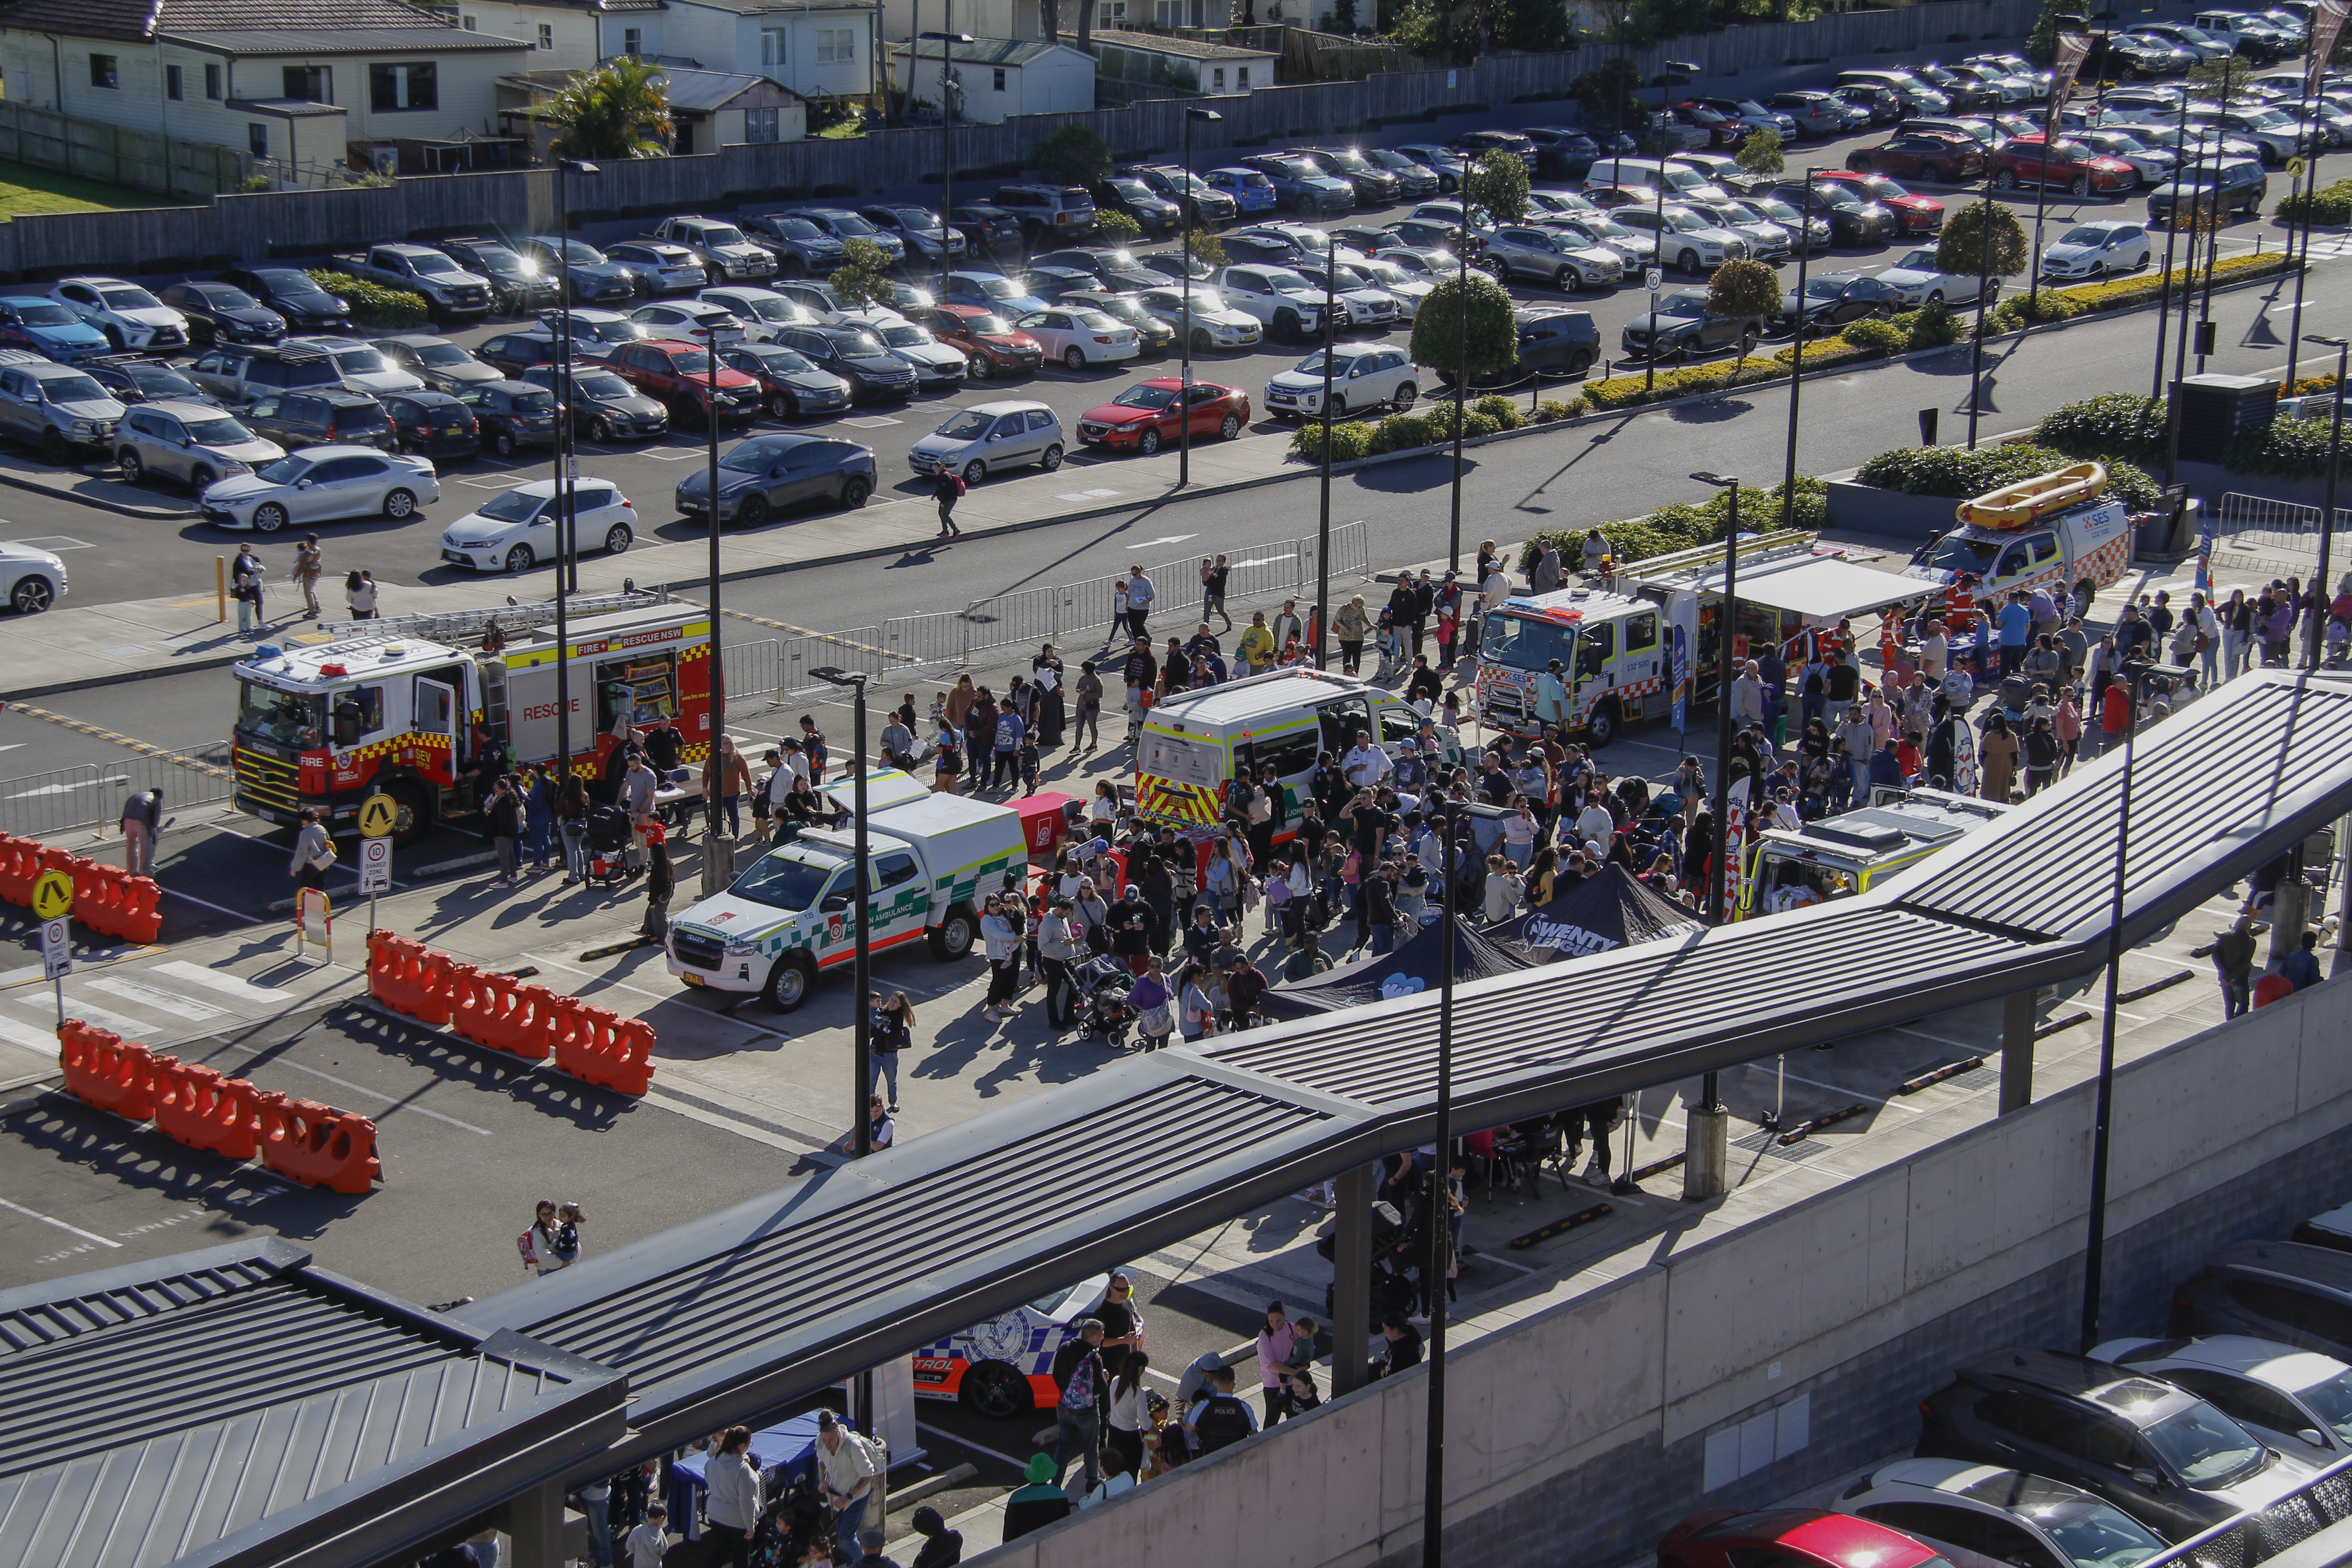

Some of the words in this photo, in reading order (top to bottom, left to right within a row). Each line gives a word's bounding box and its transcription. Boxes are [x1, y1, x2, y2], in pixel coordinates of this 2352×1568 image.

[1649, 276, 1657, 285] 10
[2092, 511, 2109, 526] SES
[578, 643, 599, 655] FIRE
[623, 632, 660, 646] RESCUE
[661, 628, 682, 640] NSW
[1627, 662, 1637, 671] 132
[1638, 659, 1649, 668] 500
[1512, 673, 1526, 683] SES
[1597, 670, 1609, 681] SES
[682, 692, 710, 701] www.fire.nsw.go
[252, 742, 279, 757] SCANIA
[415, 748, 431, 763] SEV
[301, 756, 323, 767] FIRE
[338, 774, 359, 782] RESCUE
[1289, 807, 1305, 817] JOHN
[372, 848, 381, 856] 10
[804, 912, 814, 920] 135
[848, 923, 856, 931] ST
[875, 903, 913, 922] AMBULANCE
[52, 928, 59, 937] 10
[703, 926, 723, 936] AMBULANCE
[686, 933, 706, 943] ISUZU
[1539, 921, 1620, 953] WENTY
[48, 942, 67, 953] SHARED
[52, 950, 64, 960] ZONE
[1013, 1318, 1021, 1333] WALES
[977, 1339, 990, 1354] POLICE
[912, 1359, 955, 1370] TROL
